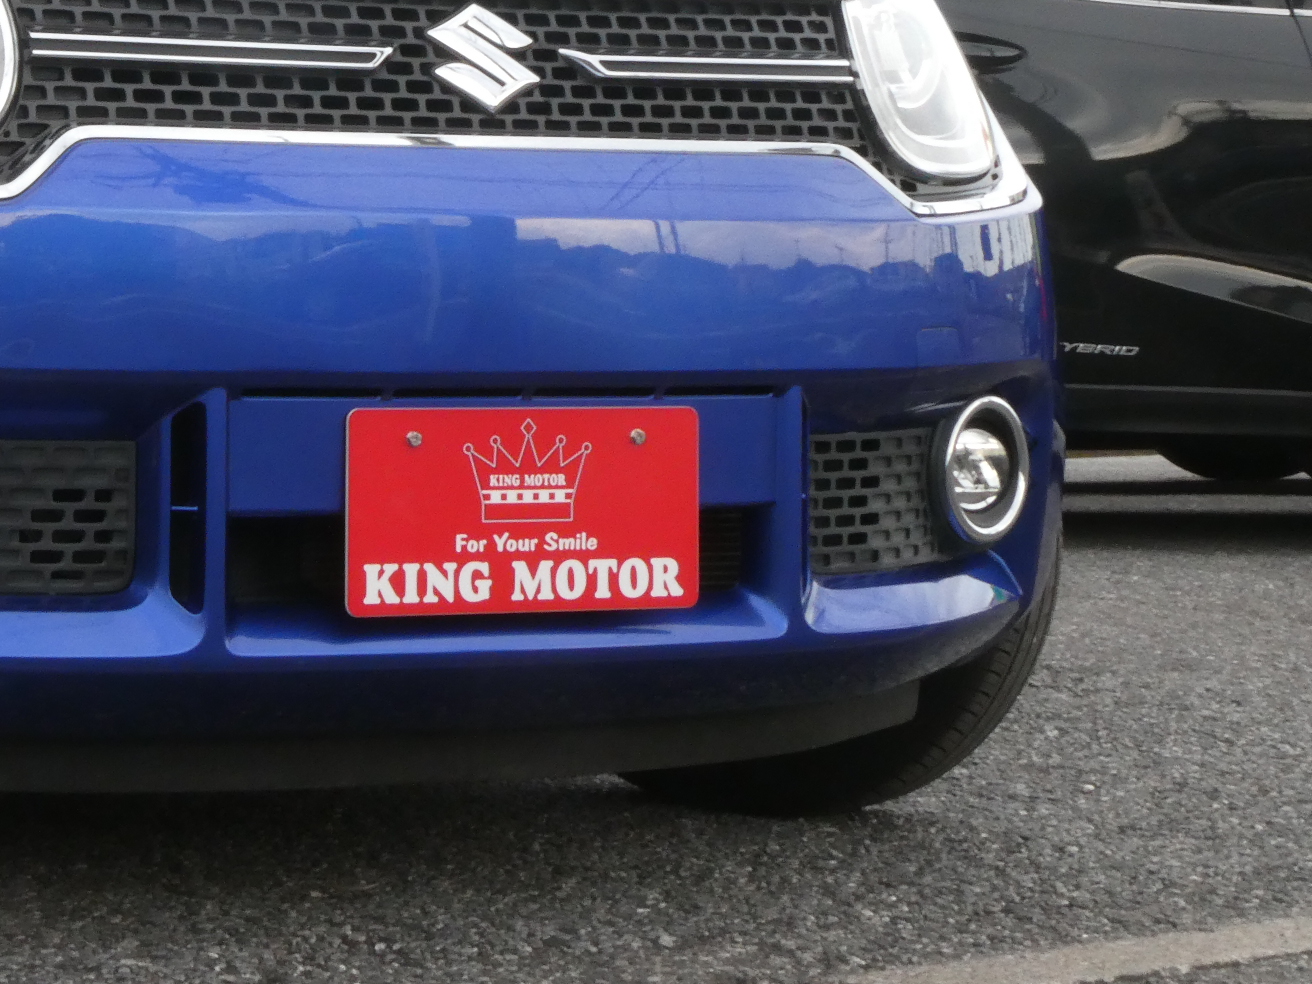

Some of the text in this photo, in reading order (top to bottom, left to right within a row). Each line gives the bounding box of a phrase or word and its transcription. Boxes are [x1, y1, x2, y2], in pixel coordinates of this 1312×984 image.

[489, 473, 567, 487] KING MOTOR
[455, 531, 599, 553] For Your Smile
[362, 556, 685, 605] KING MOTOR
